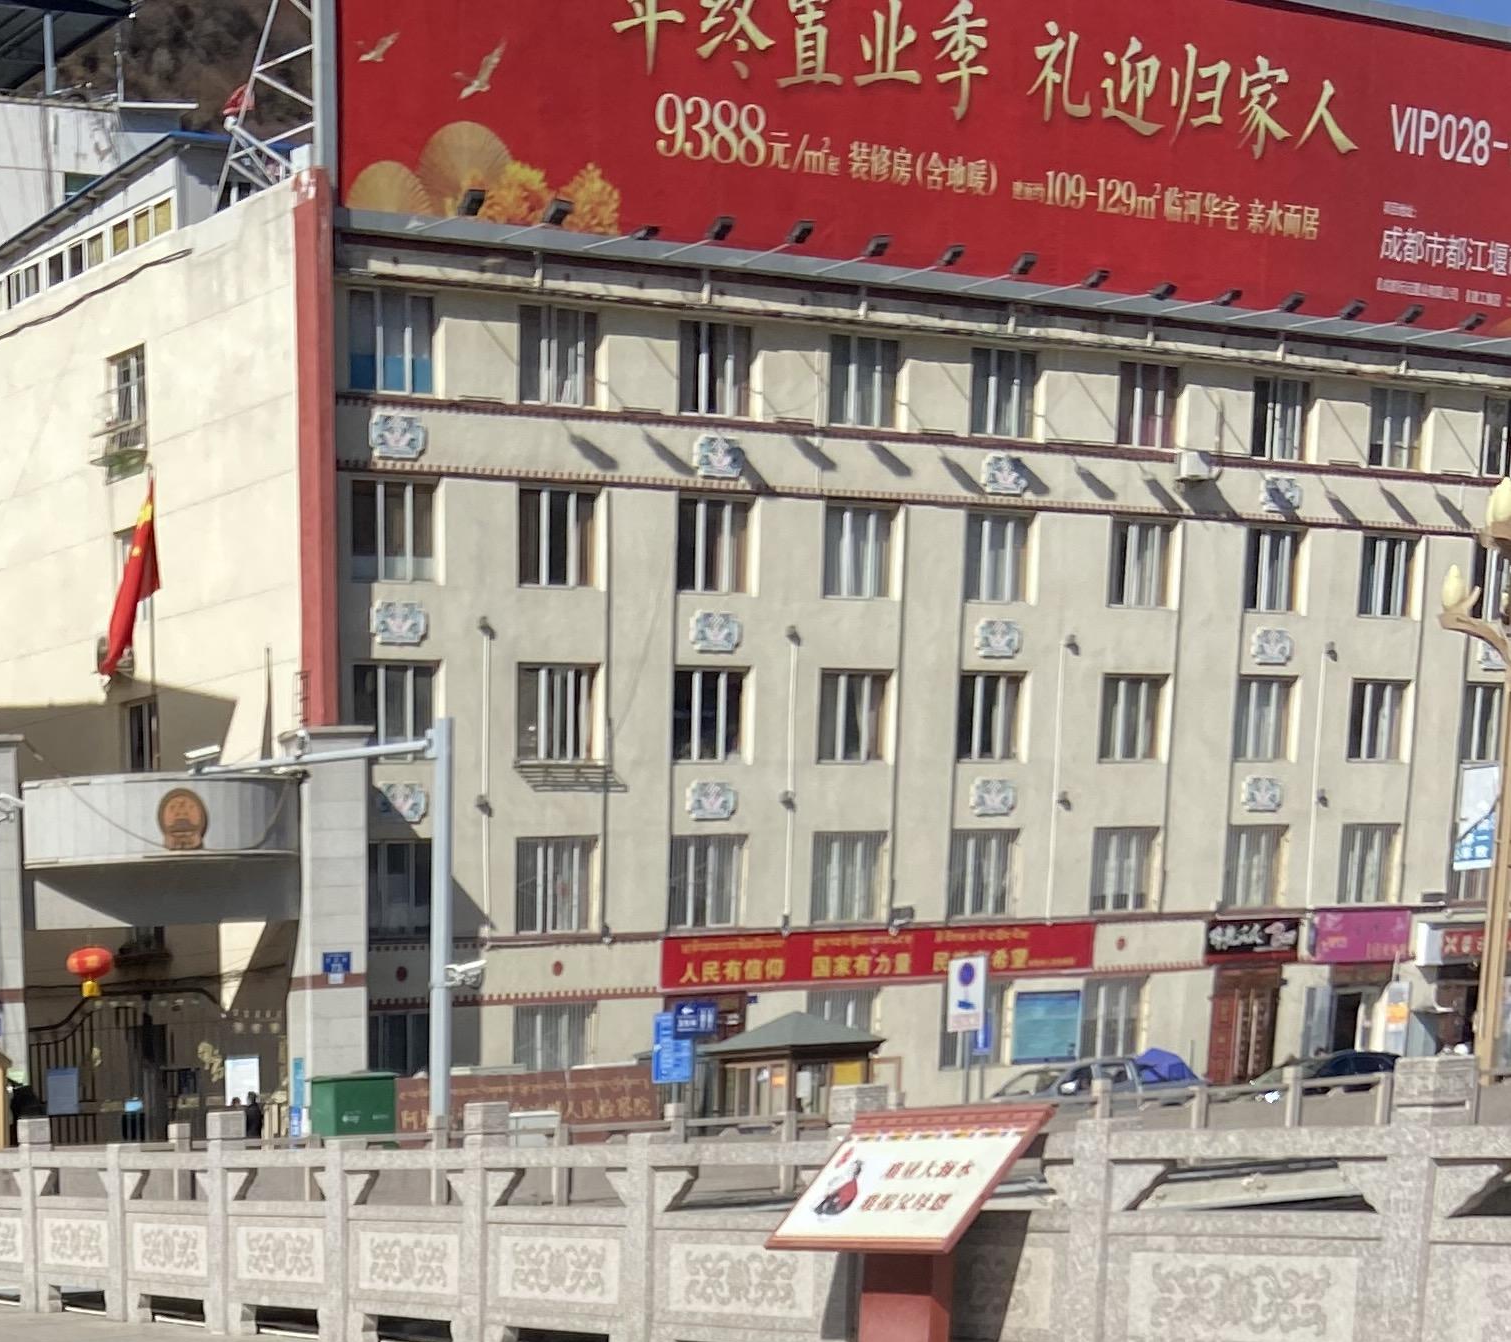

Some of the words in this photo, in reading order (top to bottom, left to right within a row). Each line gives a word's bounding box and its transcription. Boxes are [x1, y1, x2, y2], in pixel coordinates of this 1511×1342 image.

[1026, 20, 1359, 160] 礼迎归家人
[1378, 226, 1511, 277] 成都市都江堰
[679, 955, 786, 984] 人民有信仰
[810, 952, 912, 979] 国家有力量
[932, 947, 1030, 973] 民希望
